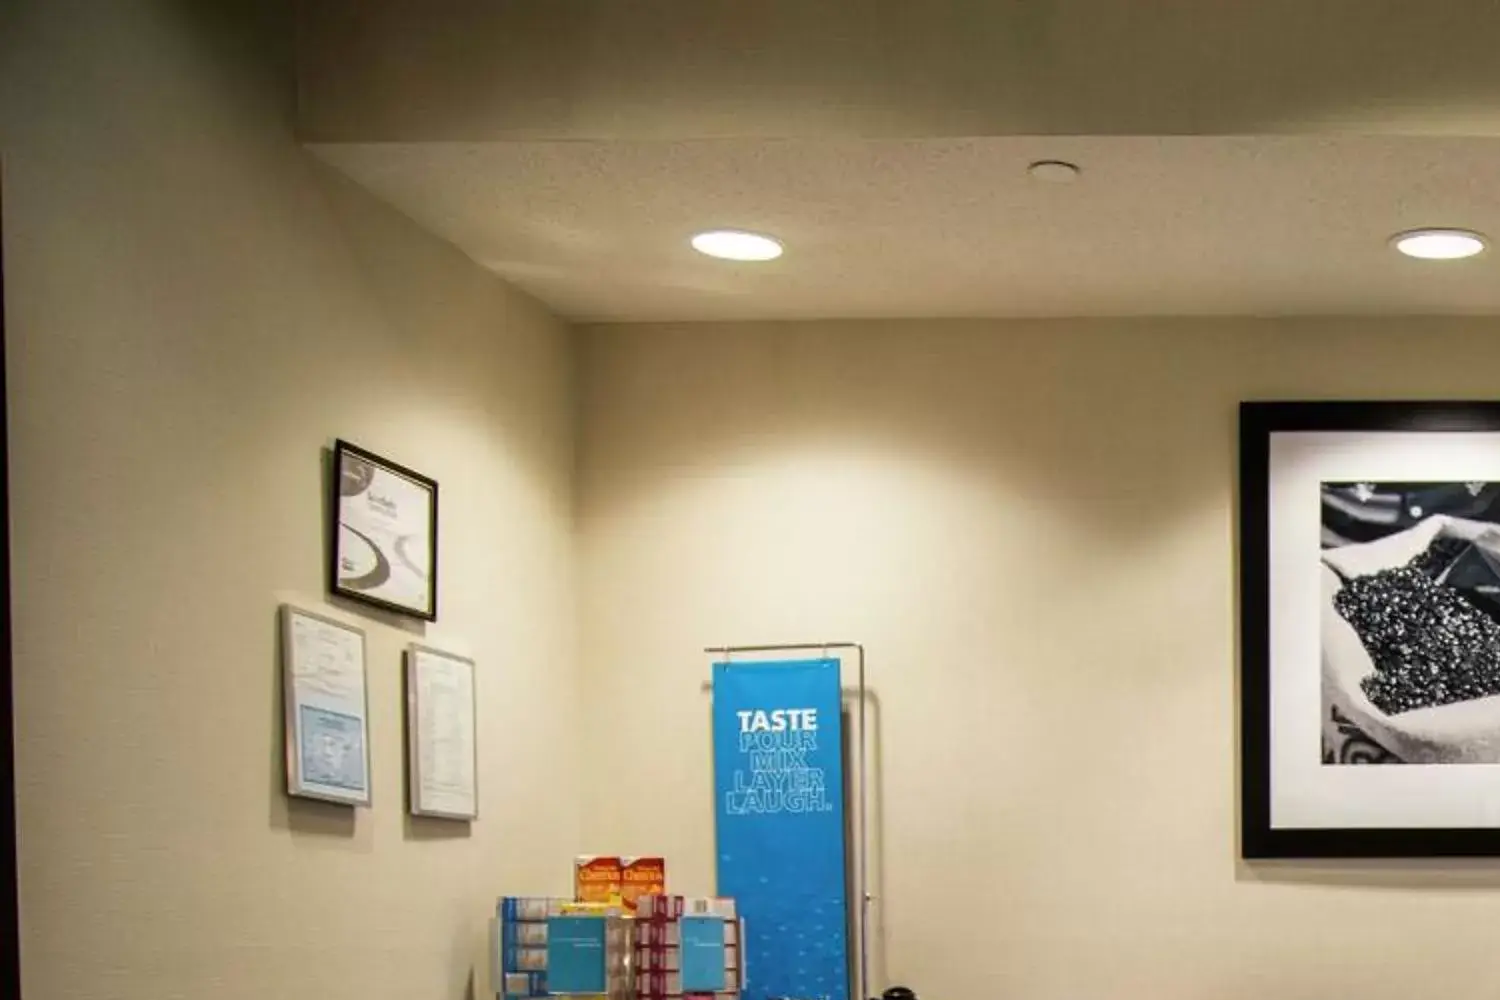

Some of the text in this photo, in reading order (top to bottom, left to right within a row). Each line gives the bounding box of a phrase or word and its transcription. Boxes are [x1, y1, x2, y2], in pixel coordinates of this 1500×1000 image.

[736, 708, 818, 732] TASTE
[739, 730, 817, 753] POUR
[750, 749, 810, 772] MIX
[734, 768, 825, 793] LAYER
[726, 790, 833, 815] LAUGH.
